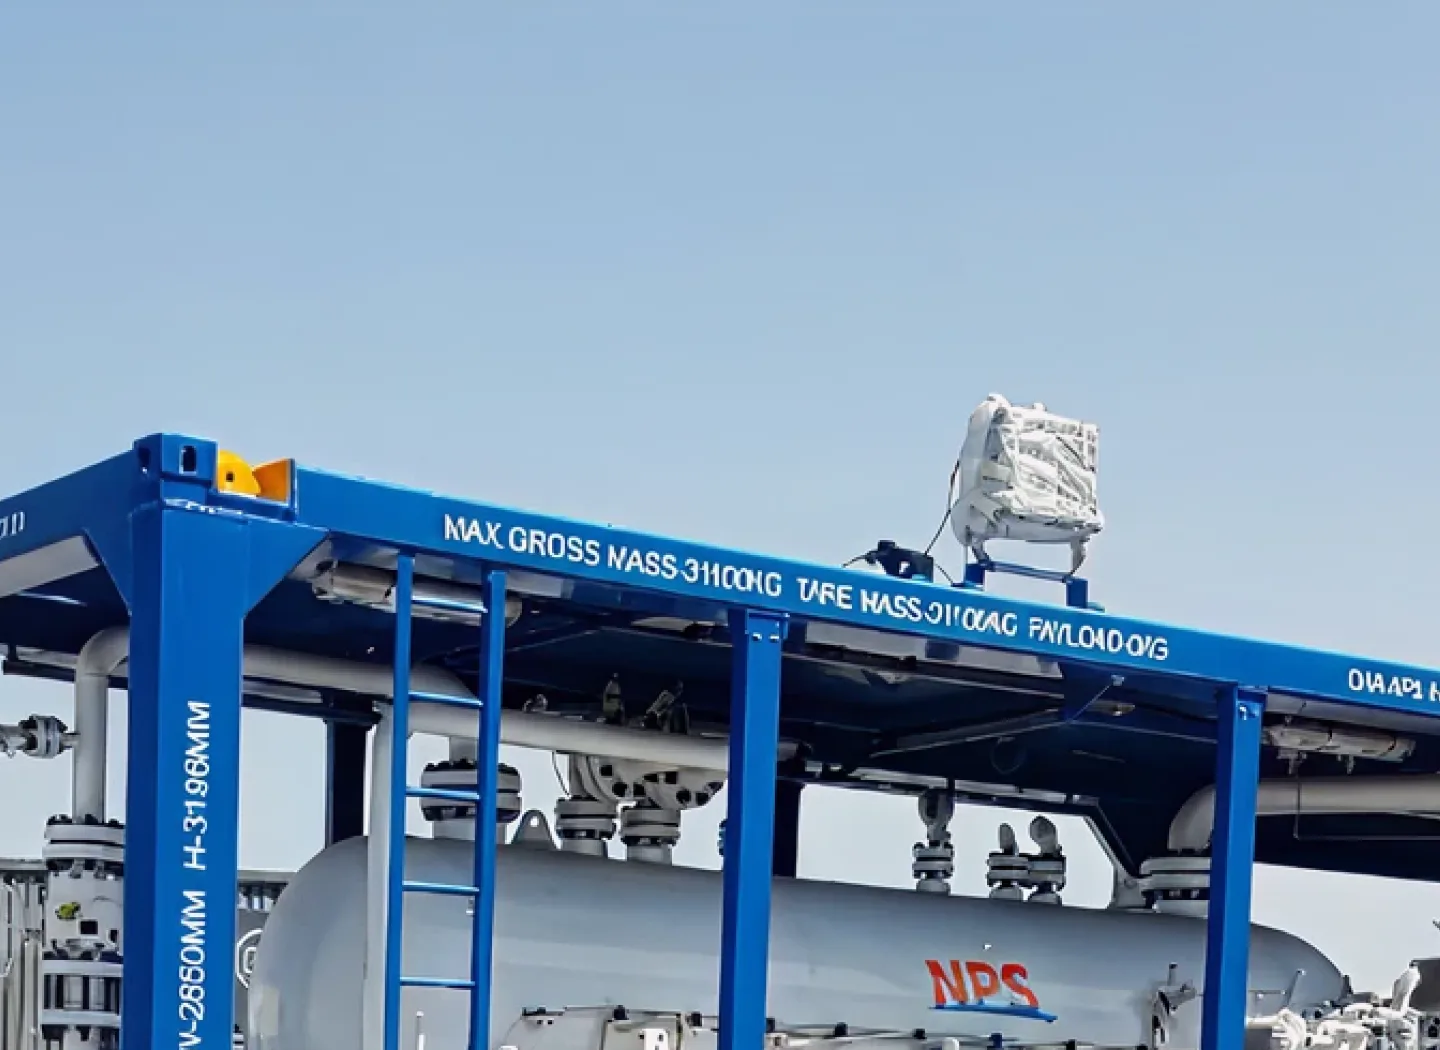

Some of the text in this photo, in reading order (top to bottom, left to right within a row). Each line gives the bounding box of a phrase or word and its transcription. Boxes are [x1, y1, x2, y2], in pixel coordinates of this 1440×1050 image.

[508, 526, 600, 567] GROSS
[796, 577, 853, 610] TARE
[925, 959, 1039, 1008] NPS
